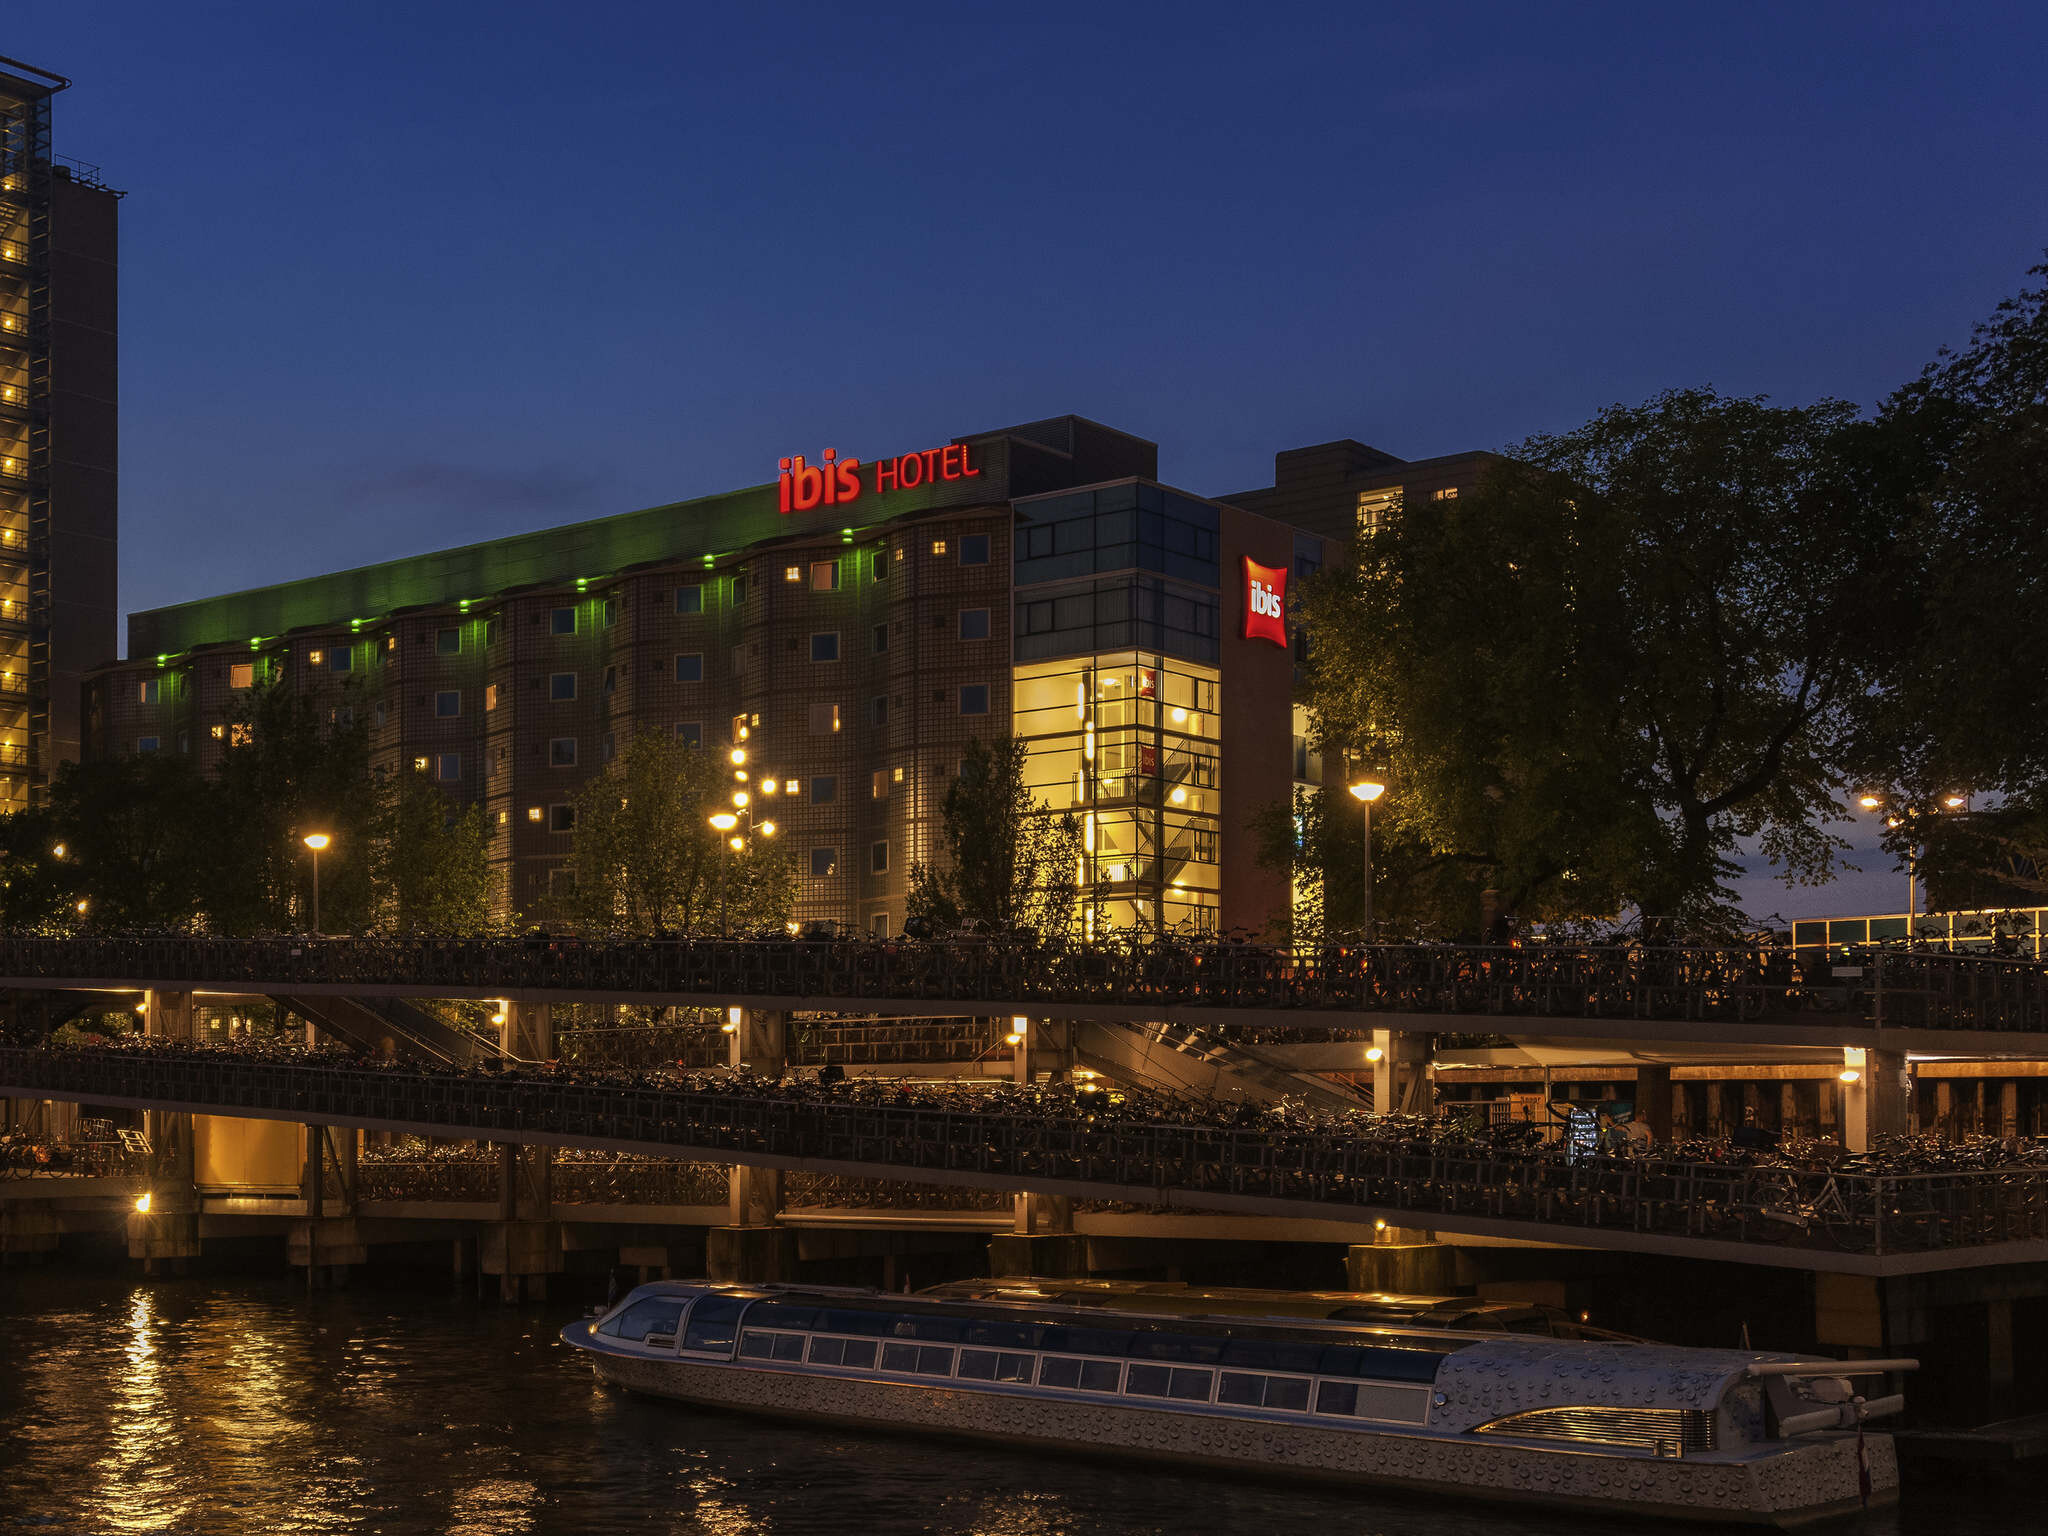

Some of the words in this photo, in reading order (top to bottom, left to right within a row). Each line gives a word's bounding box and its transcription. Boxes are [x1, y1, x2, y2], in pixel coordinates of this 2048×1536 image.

[779, 448, 861, 513] ibis
[876, 444, 979, 493] HOTEL
[1251, 580, 1280, 618] ibis
